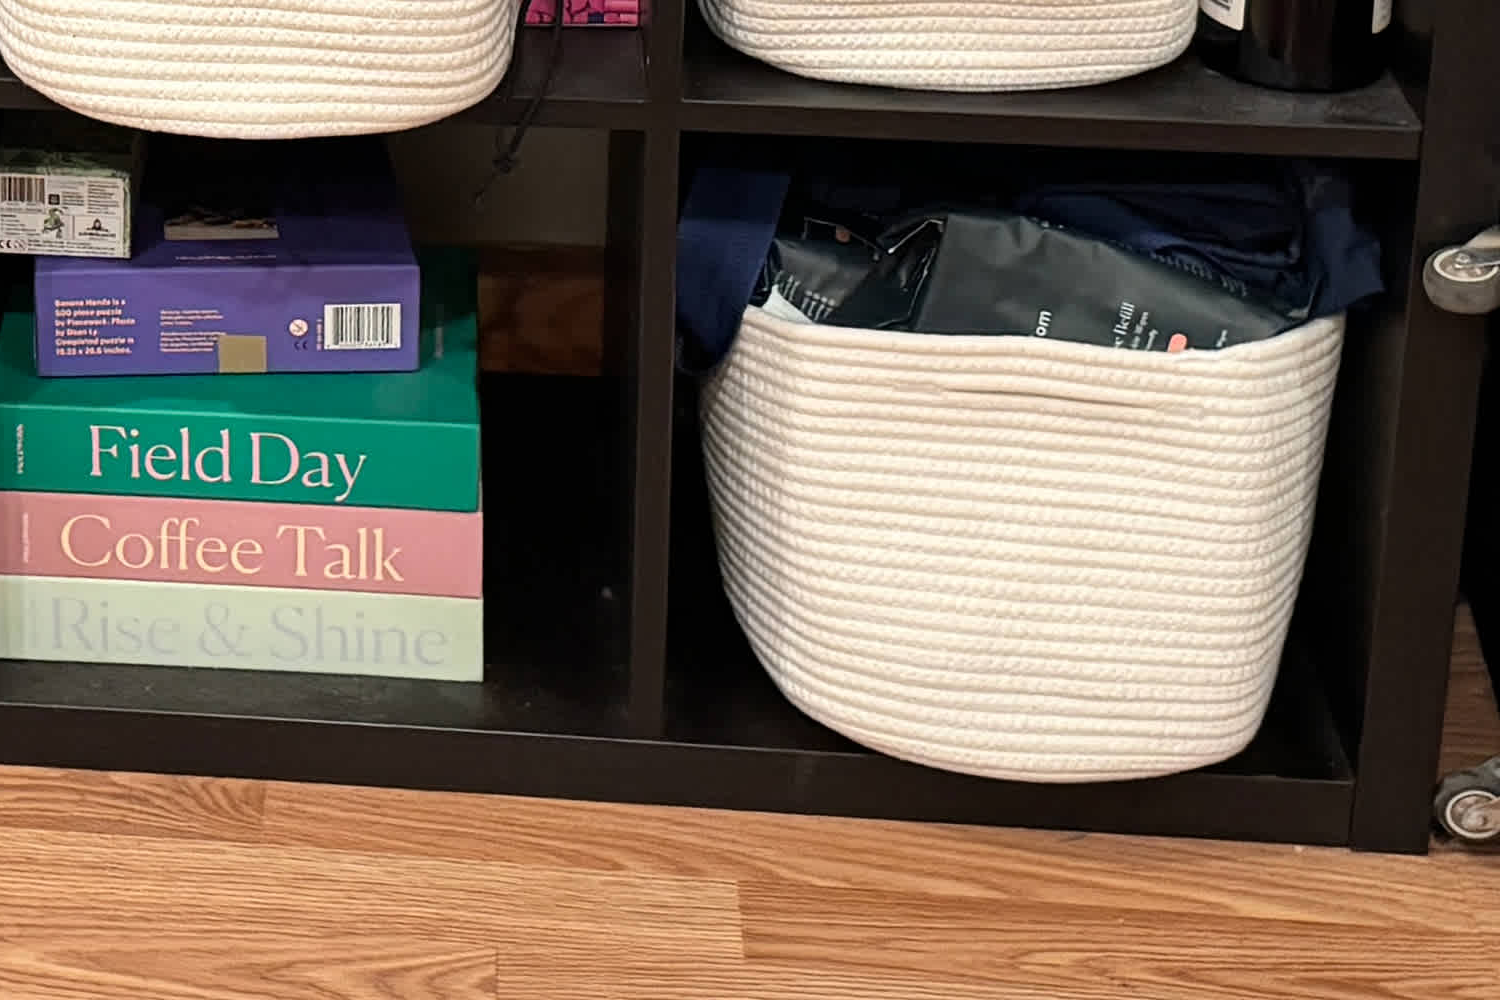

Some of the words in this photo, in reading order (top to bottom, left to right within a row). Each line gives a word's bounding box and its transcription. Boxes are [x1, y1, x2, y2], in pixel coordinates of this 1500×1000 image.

[89, 424, 232, 484] Field
[250, 431, 367, 502] Day
[60, 513, 265, 575] Coffee
[276, 524, 405, 582] Talk
[50, 596, 182, 655] Rise
[199, 600, 252, 658] &
[268, 603, 450, 666] Shine
